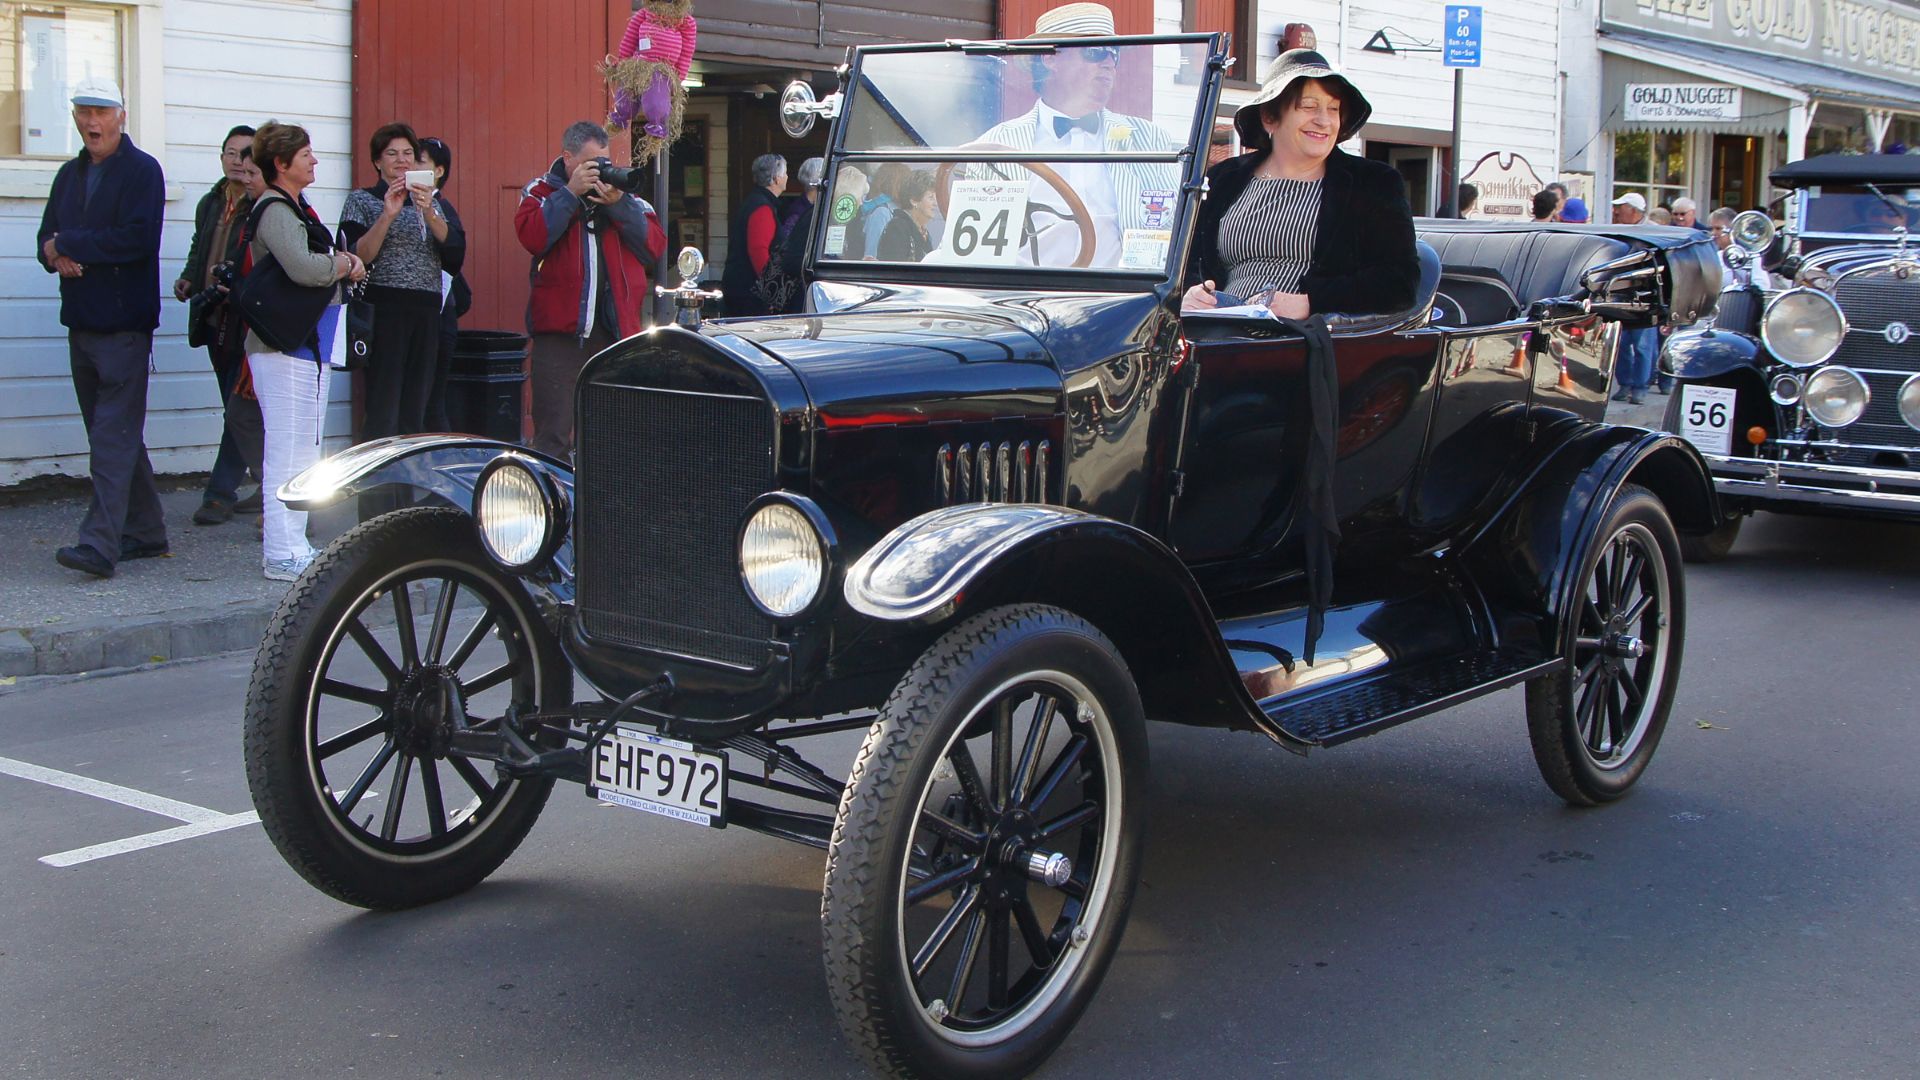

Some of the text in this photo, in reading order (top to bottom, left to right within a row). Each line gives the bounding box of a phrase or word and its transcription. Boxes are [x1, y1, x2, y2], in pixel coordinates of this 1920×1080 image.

[1458, 9, 1469, 23] P
[1726, 0, 1813, 44] GOLD
[1457, 26, 1469, 37] 60
[1633, 87, 1738, 104] GOLD NUGGET
[1641, 106, 1664, 116] GIFTS
[1667, 107, 1672, 116] &
[1142, 190, 1174, 198] CENTENARY
[952, 209, 1010, 257] 64
[1688, 400, 1727, 428] 56
[595, 739, 719, 810] EHF972
[600, 791, 621, 803] MODEL
[626, 798, 642, 808] FORD
[642, 802, 658, 812] CLUB
[658, 805, 667, 813] OF
[667, 807, 681, 817] NEW
[681, 810, 709, 824] ZEALAND
